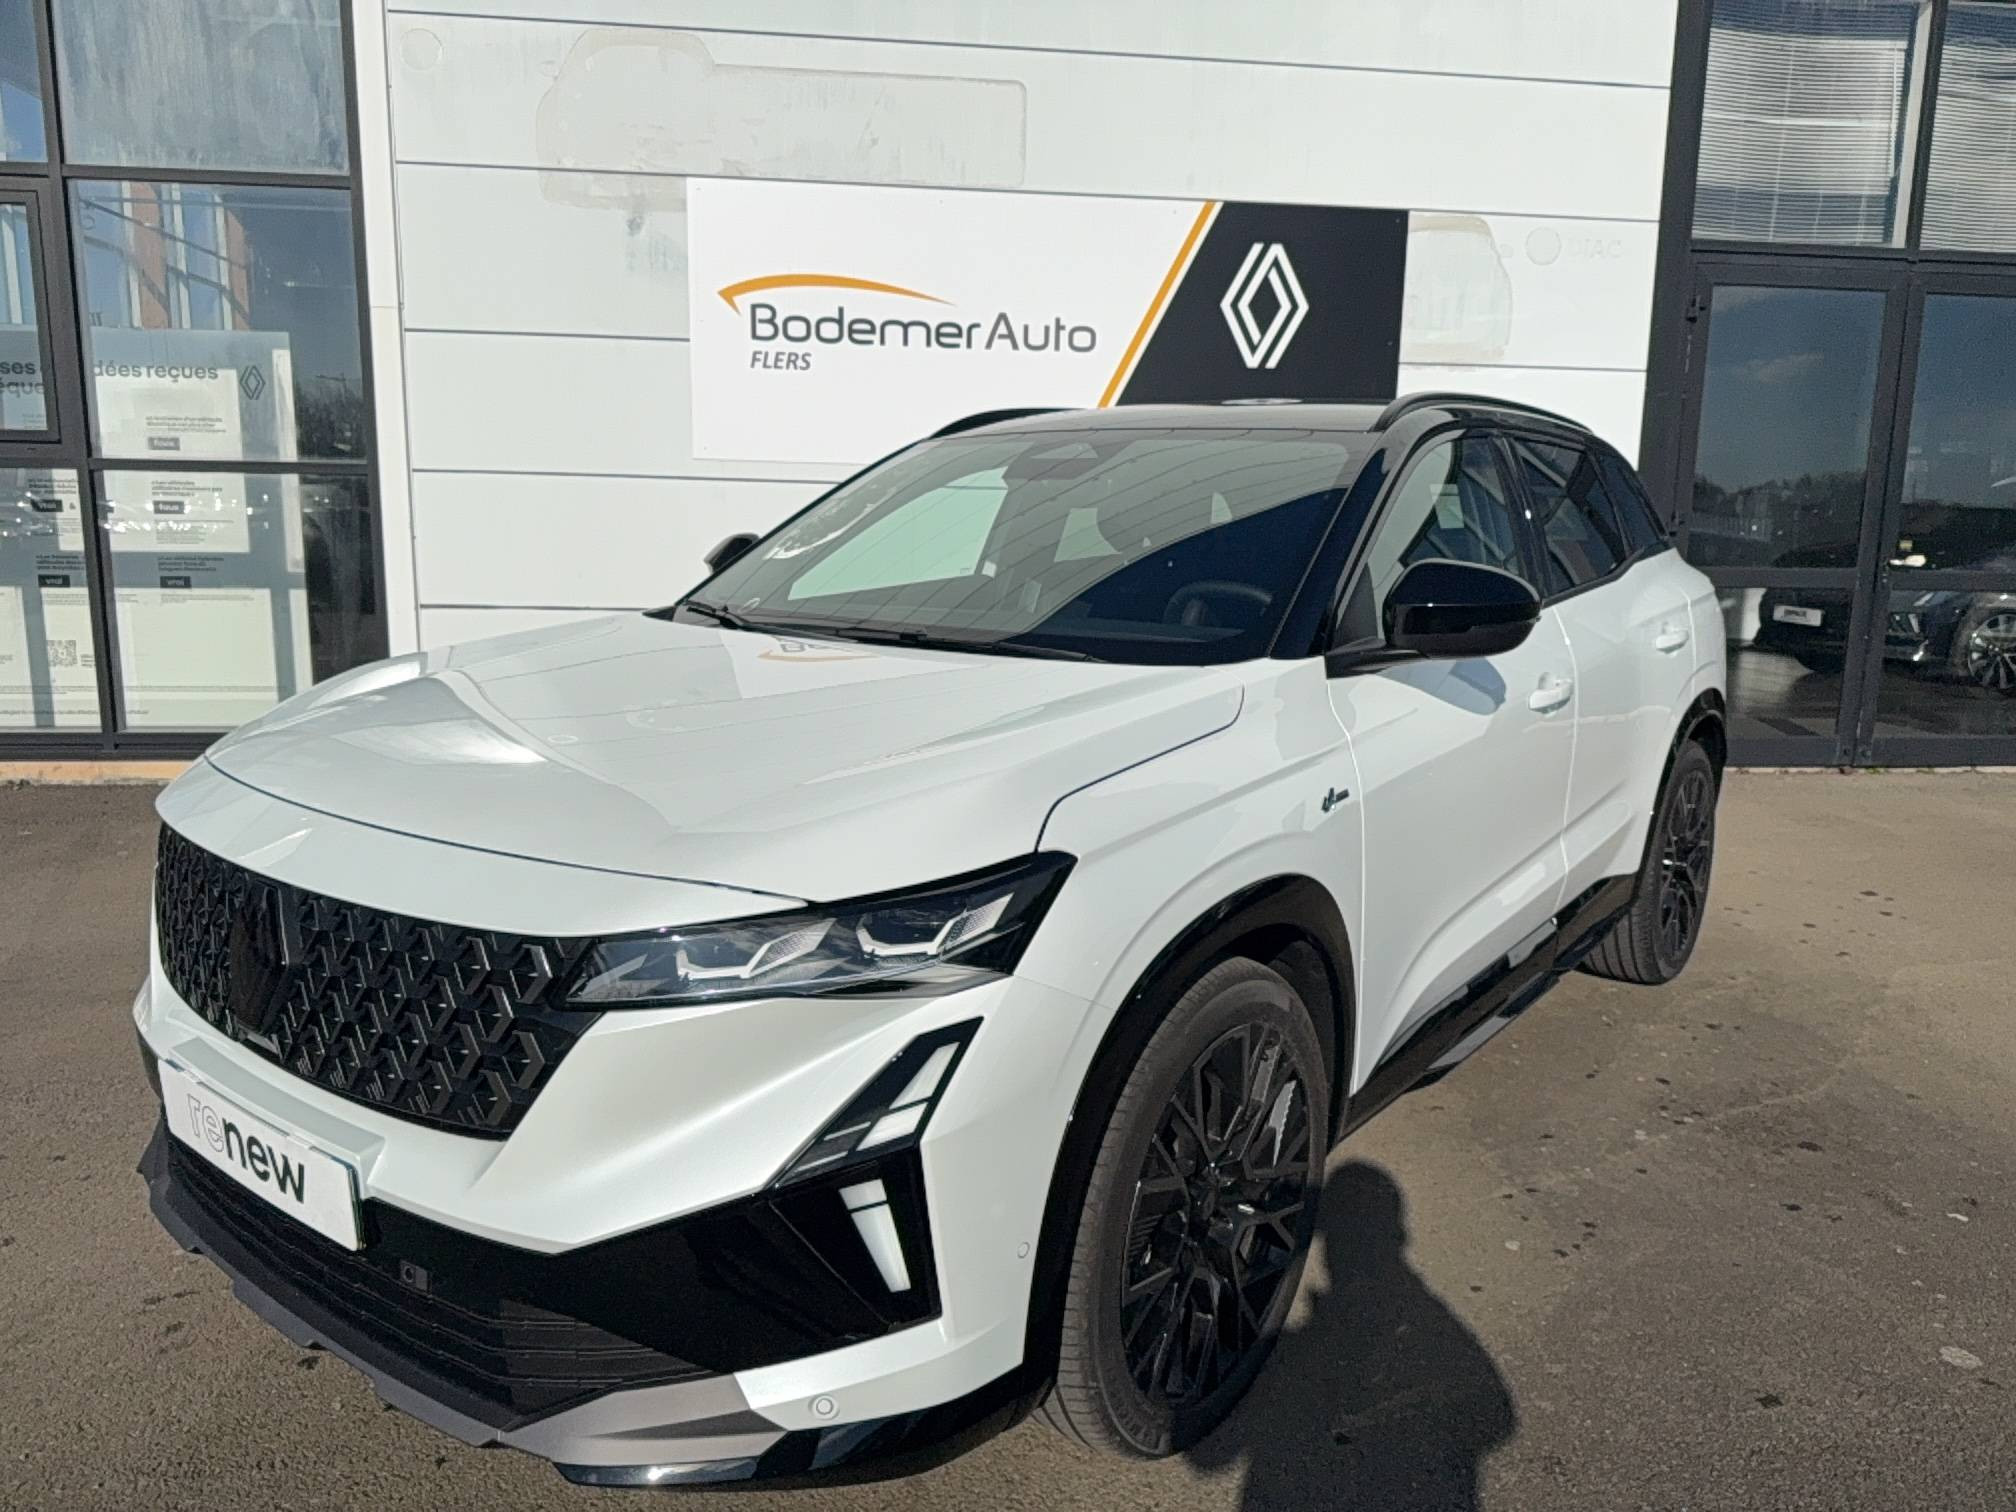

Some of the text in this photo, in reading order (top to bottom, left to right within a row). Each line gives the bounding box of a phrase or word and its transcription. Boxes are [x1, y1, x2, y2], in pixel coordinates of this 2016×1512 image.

[750, 351, 812, 371] FLERS
[145, 364, 219, 384] reçues
[187, 1093, 305, 1204] renew
